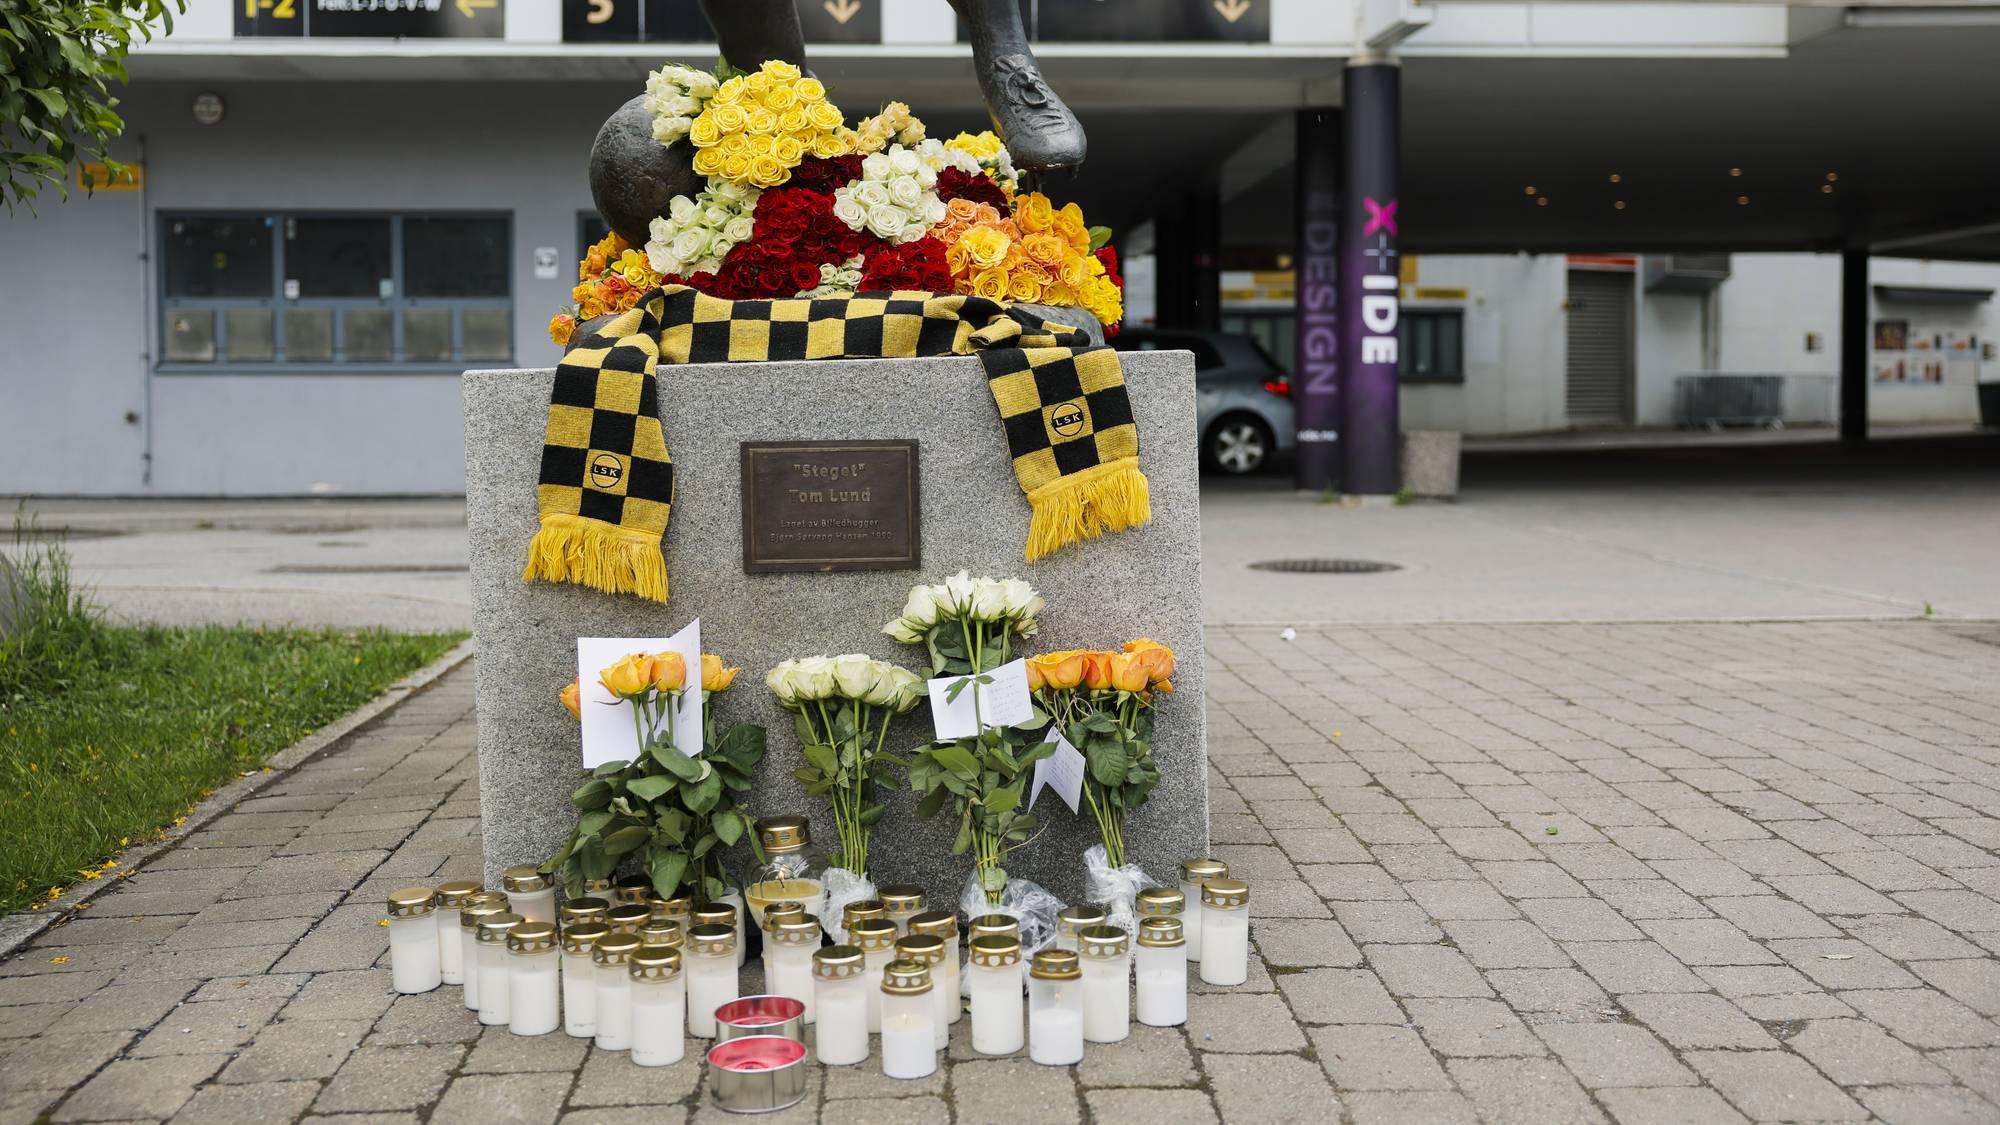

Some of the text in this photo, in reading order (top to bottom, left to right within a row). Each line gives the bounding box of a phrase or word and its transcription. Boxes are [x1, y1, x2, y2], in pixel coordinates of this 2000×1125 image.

[1305, 220, 1337, 395] DESIGN
[1055, 413, 1081, 426] LSK
[593, 465, 618, 477] LSK
[788, 487, 873, 503] Tom Lund
